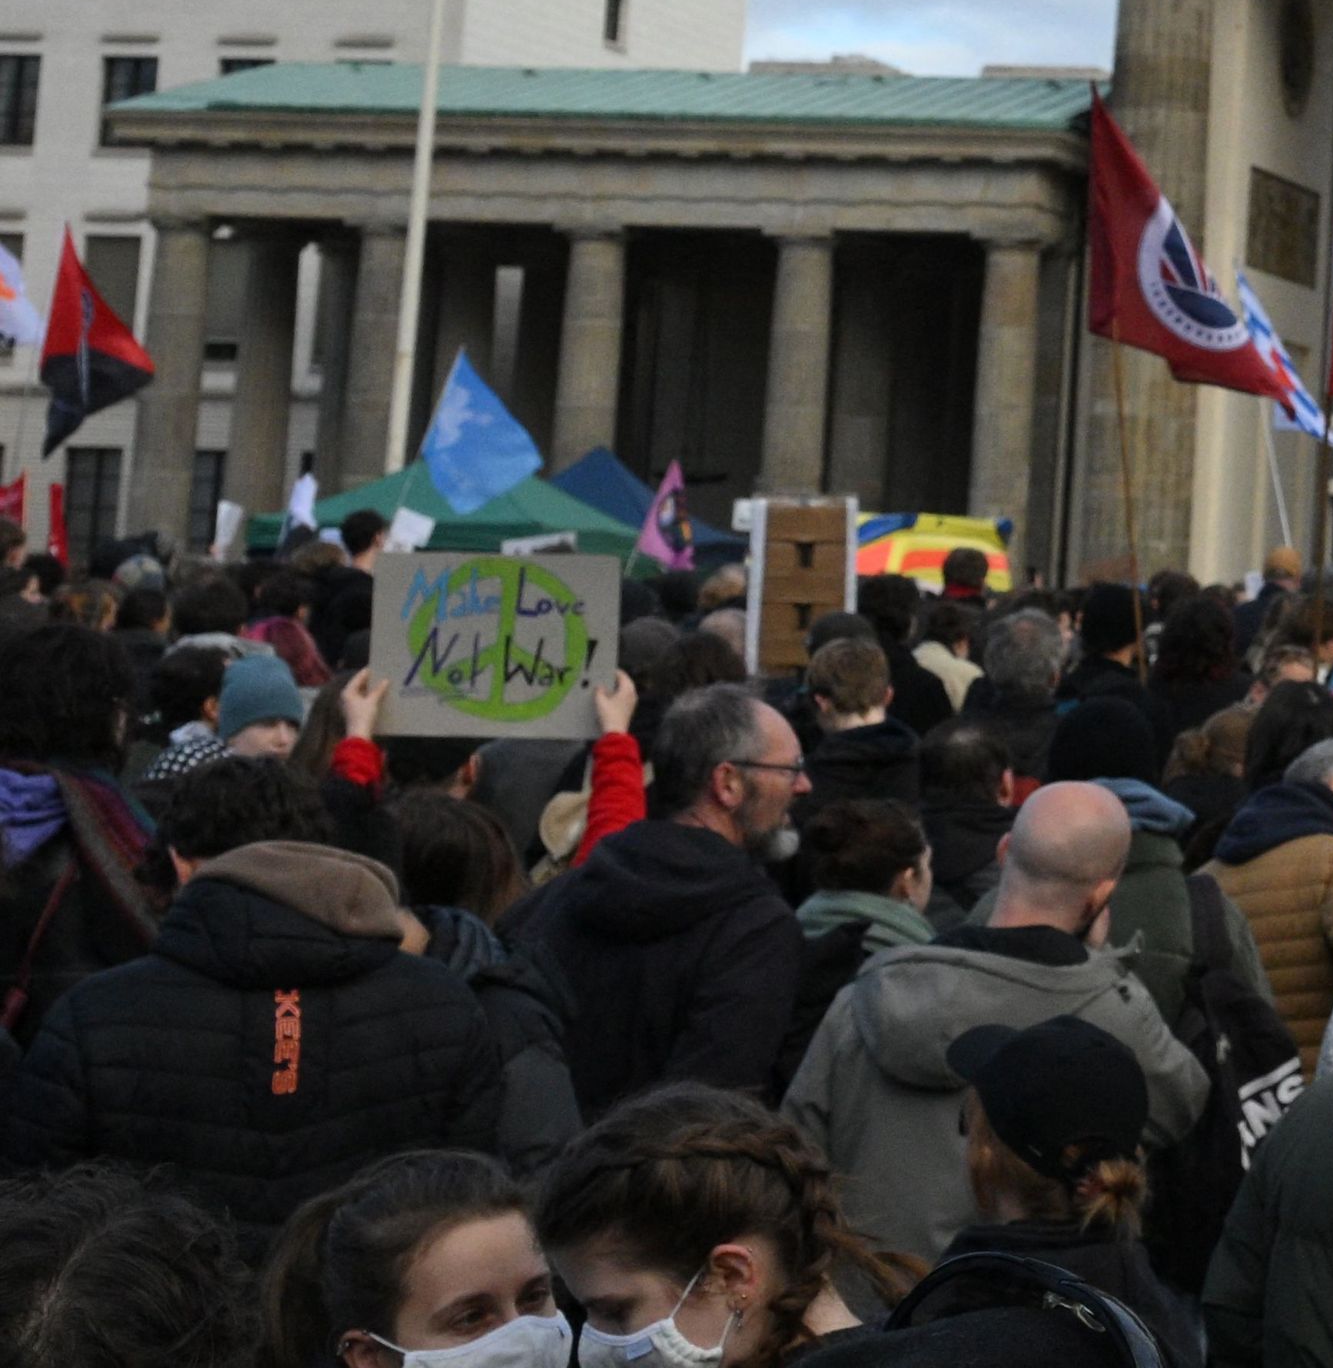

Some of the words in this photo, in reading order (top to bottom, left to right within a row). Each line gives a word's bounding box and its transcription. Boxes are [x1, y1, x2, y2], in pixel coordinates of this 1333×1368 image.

[401, 565, 501, 624] Make
[515, 565, 586, 618] Love
[404, 627, 482, 688] Not
[504, 635, 598, 688] War!
